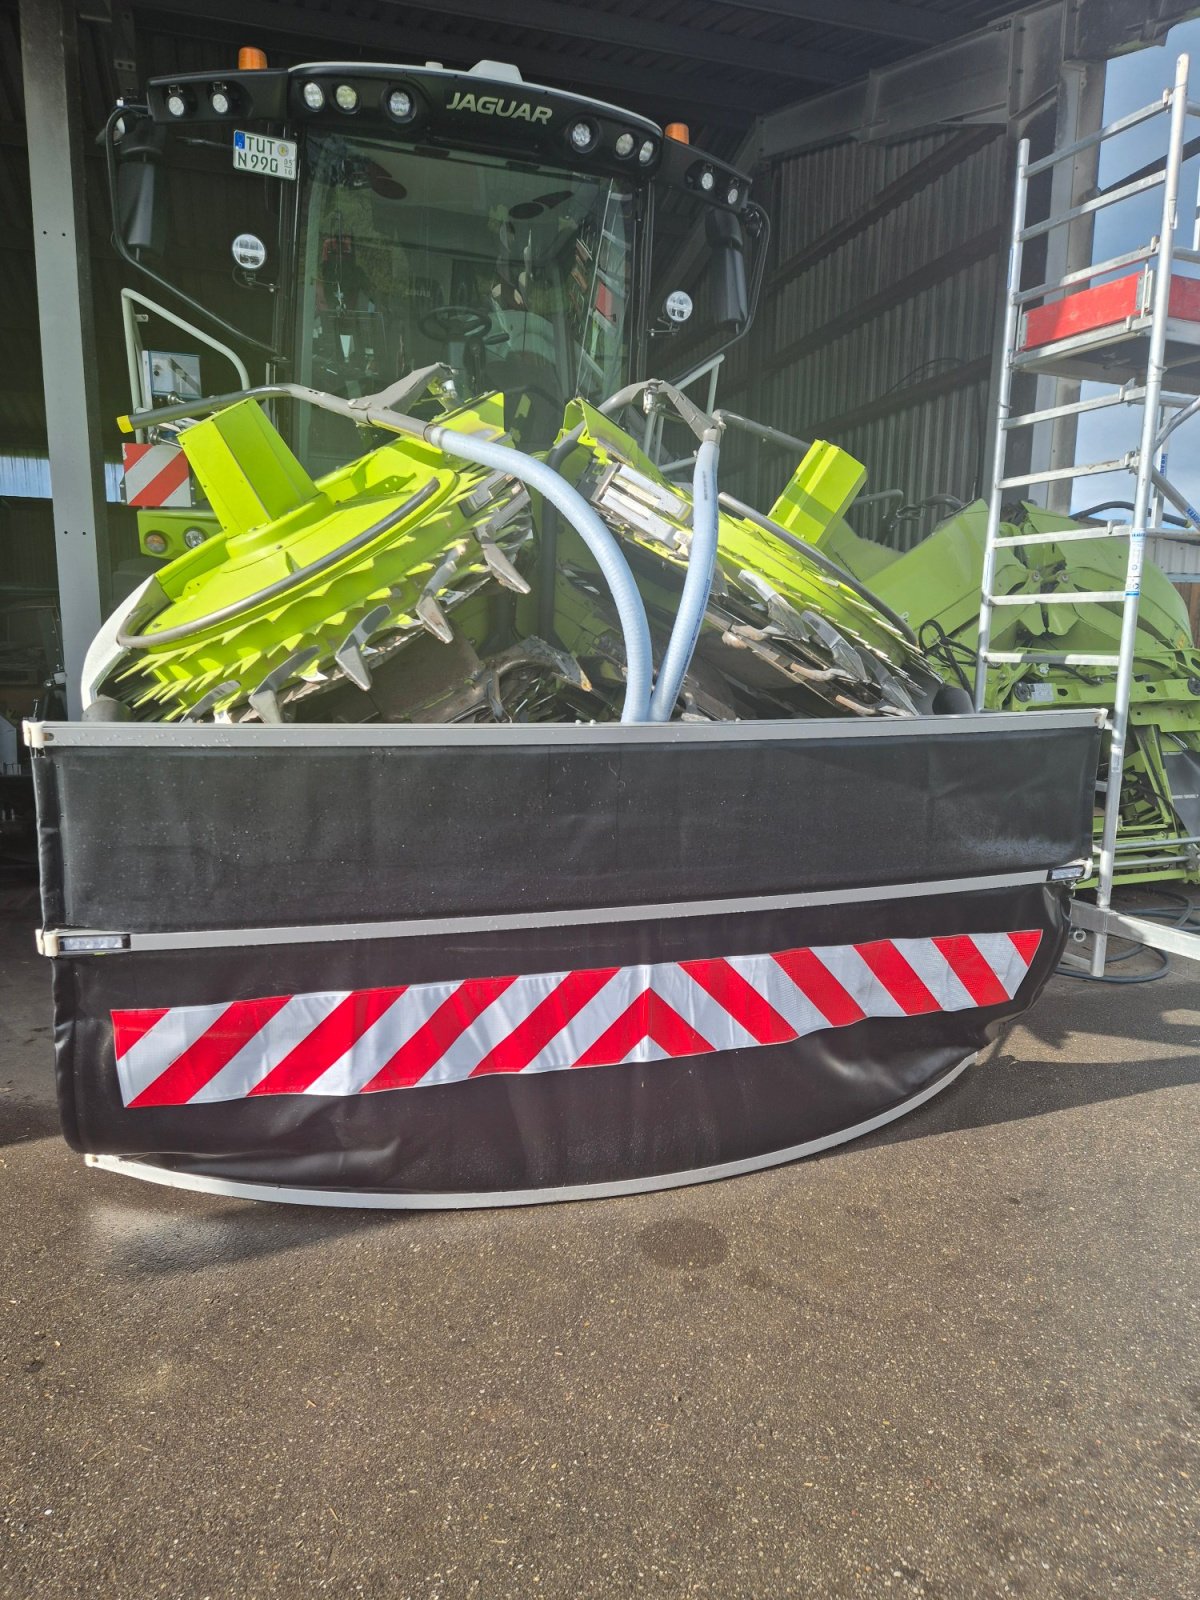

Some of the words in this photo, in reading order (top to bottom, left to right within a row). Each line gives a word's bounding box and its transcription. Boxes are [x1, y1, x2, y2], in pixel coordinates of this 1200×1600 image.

[446, 92, 553, 125] JAGUAR
[246, 135, 275, 155] TUT
[237, 151, 247, 167] N
